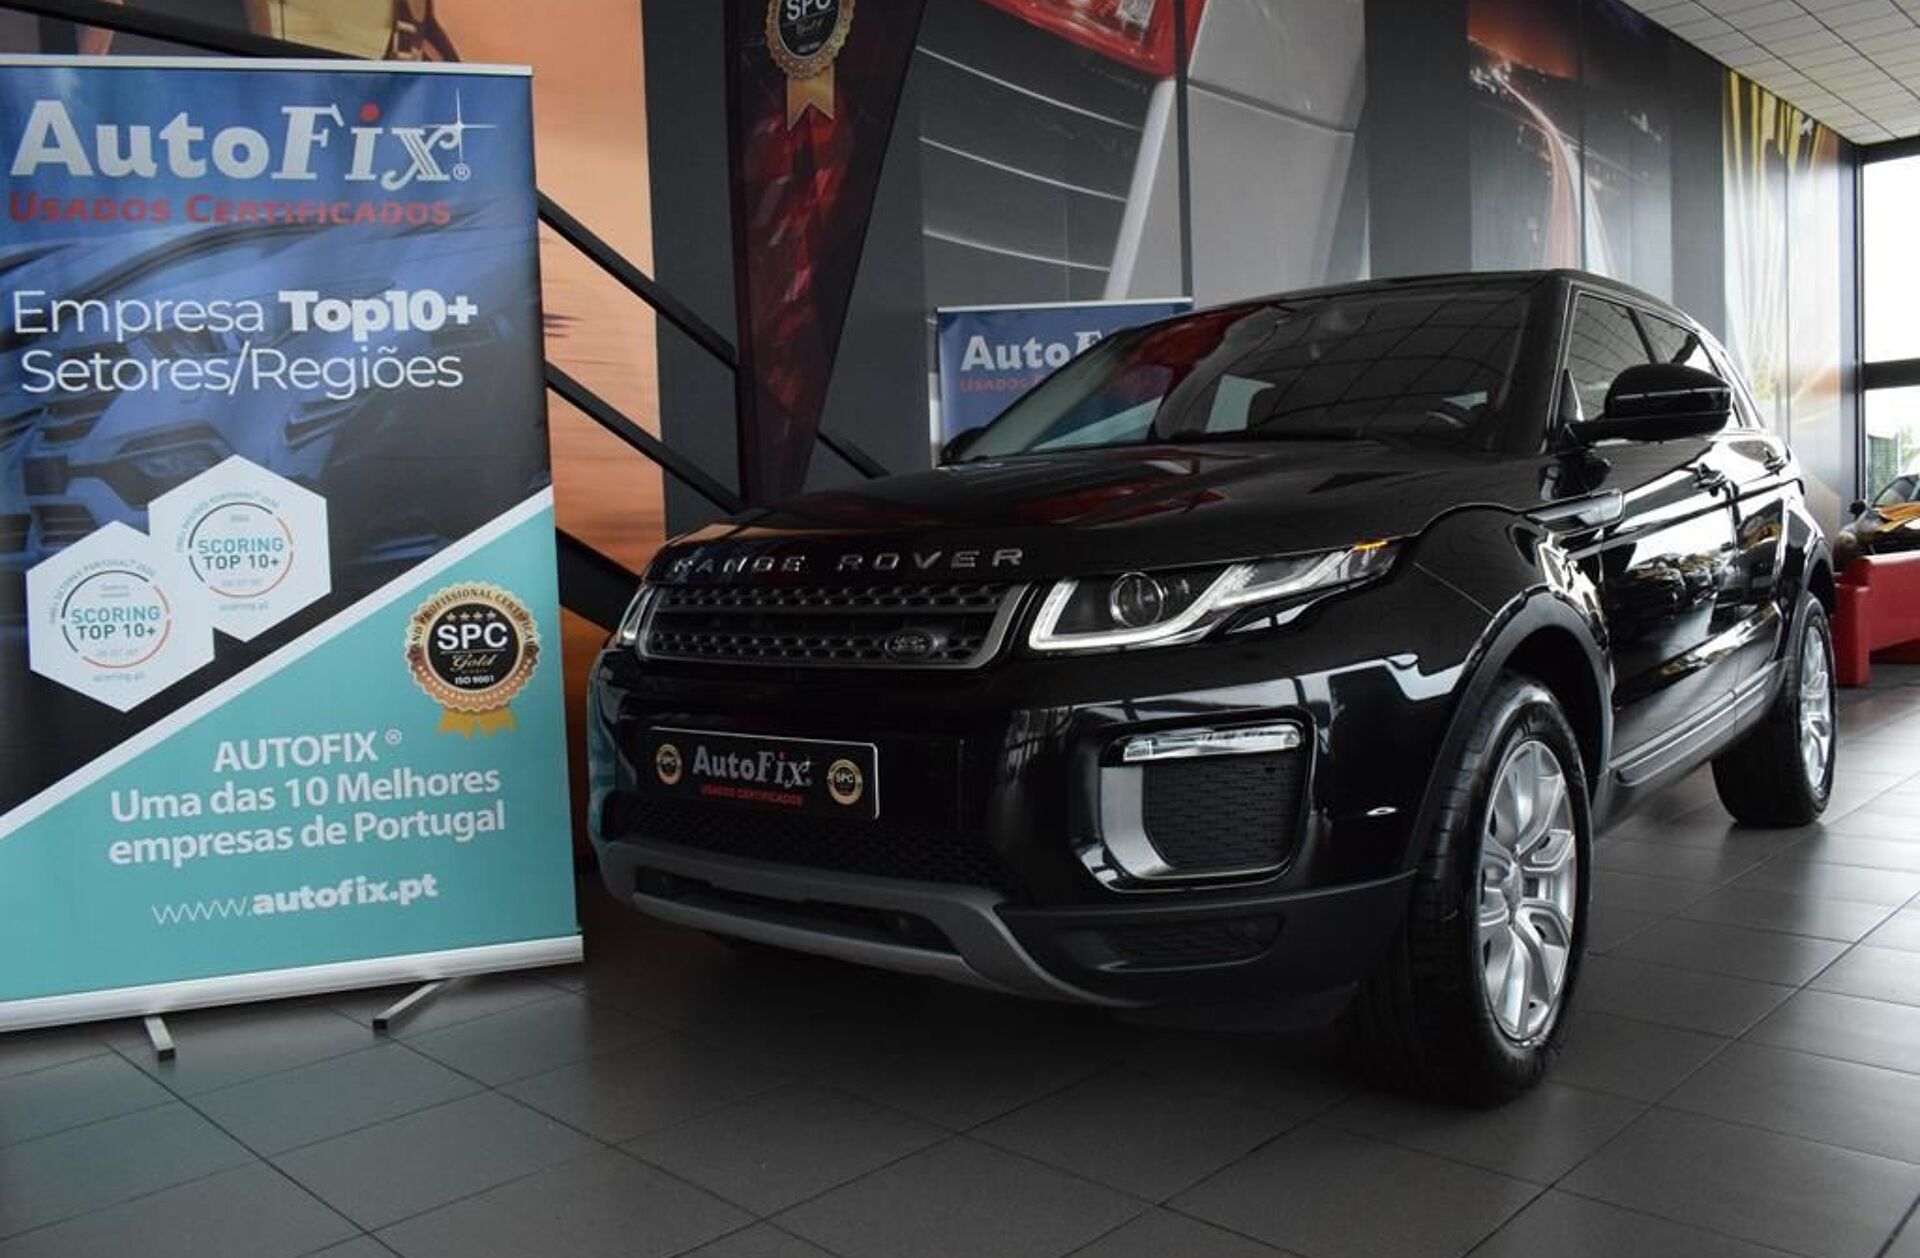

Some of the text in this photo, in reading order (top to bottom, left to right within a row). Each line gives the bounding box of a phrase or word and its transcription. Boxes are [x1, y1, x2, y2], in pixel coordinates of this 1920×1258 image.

[13, 288, 478, 343] Empresa Top10+
[21, 340, 464, 400] Setores/Regiões
[198, 537, 284, 555] SCORING
[202, 554, 280, 570] TOP 10+
[673, 548, 1023, 574] RANGE ROVER
[71, 606, 161, 624] SCORING
[76, 622, 156, 640] TOP 10+
[437, 622, 509, 650] SPC
[455, 676, 472, 686] ISO
[213, 730, 379, 773] AUTOFIX
[109, 768, 501, 823] Uma das 10 Melhores
[107, 800, 506, 868] empresas de Portugal
[151, 873, 439, 926] www.autofix.pt
